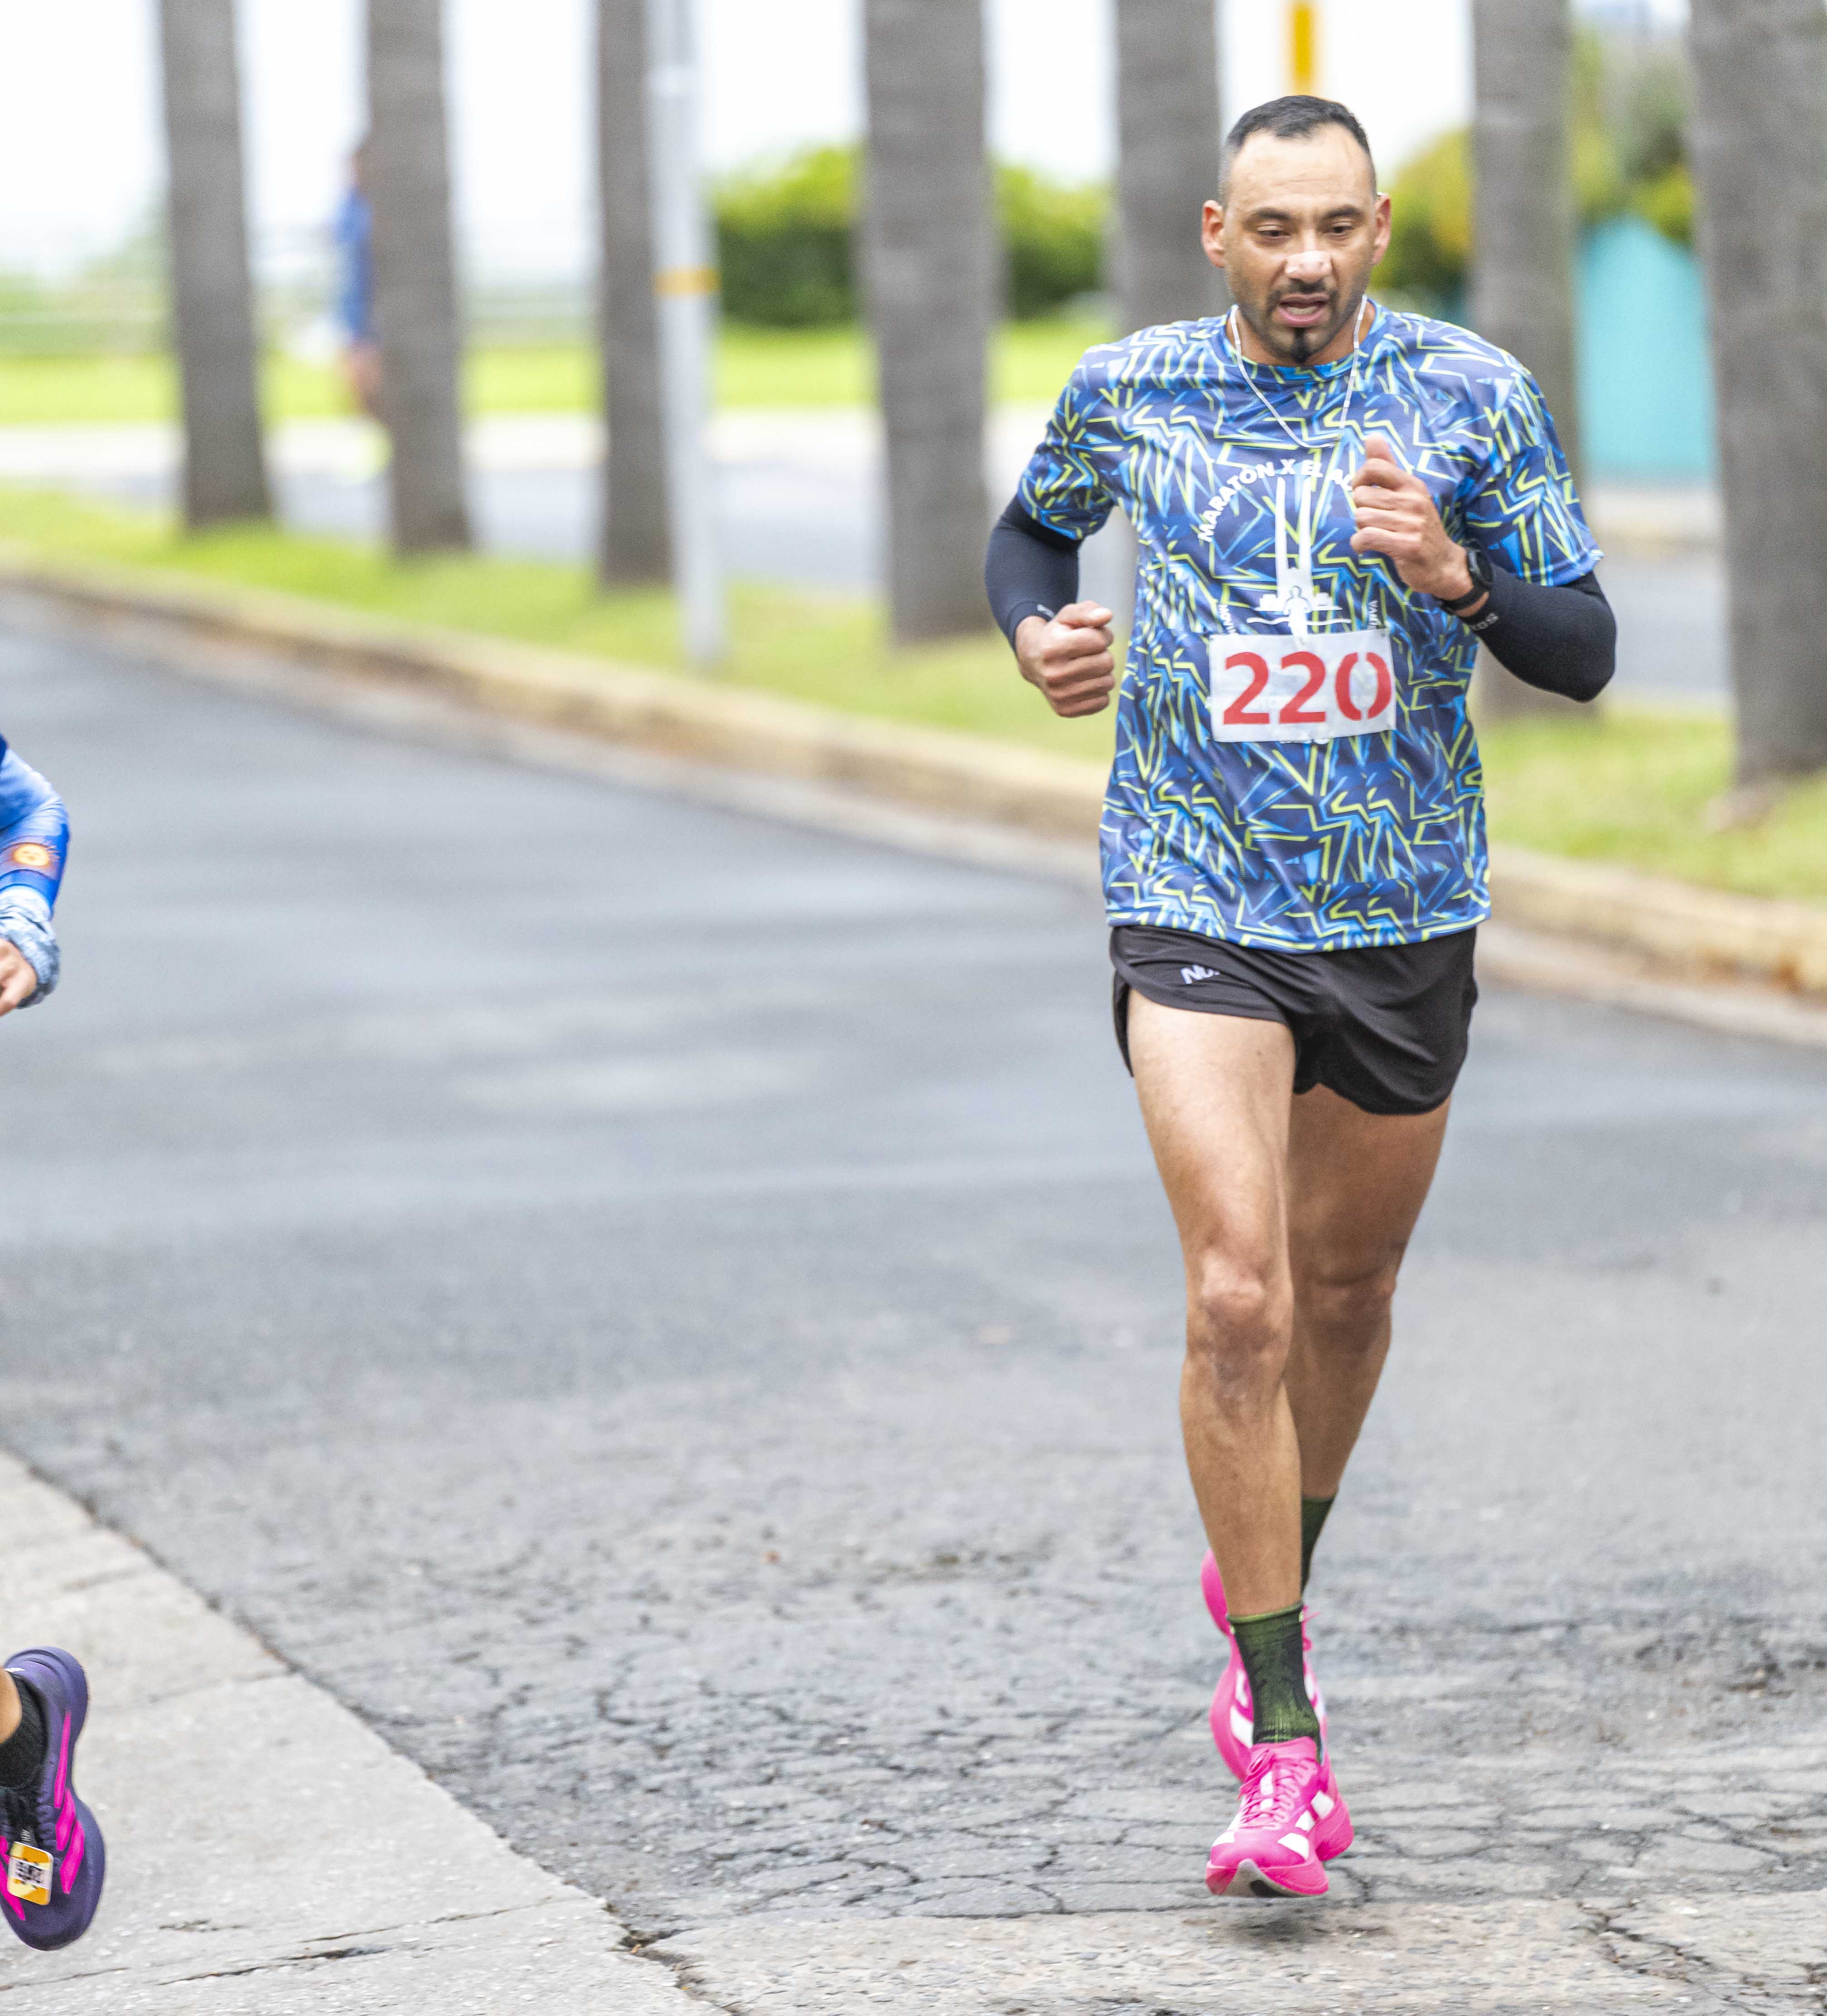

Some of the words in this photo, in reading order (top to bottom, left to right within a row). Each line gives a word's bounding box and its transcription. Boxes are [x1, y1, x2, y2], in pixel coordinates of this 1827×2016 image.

[1198, 461, 1275, 543] MARATON
[1279, 459, 1296, 475] X
[1301, 459, 1324, 478] EL
[1223, 651, 1392, 725] 220
